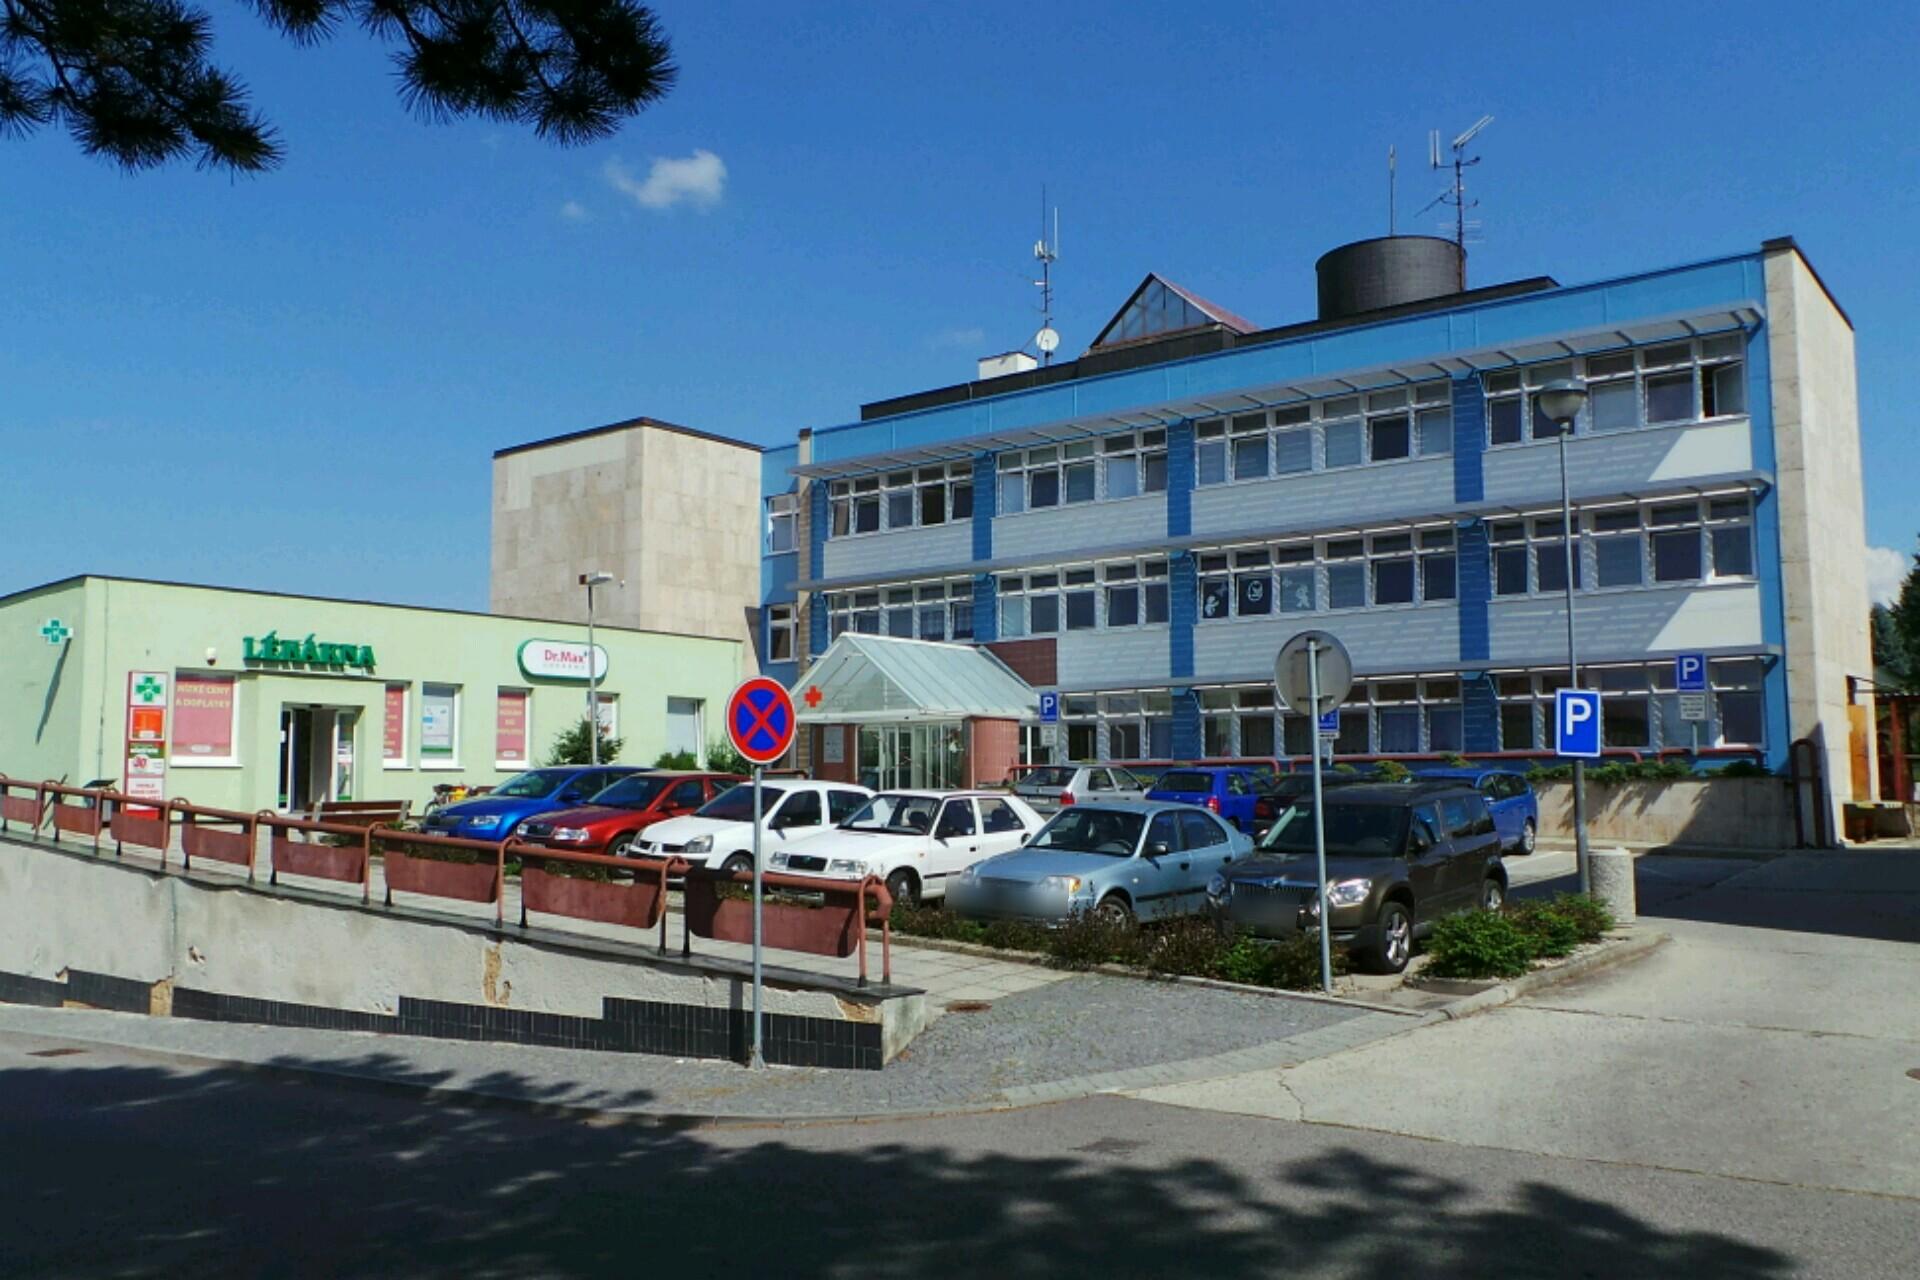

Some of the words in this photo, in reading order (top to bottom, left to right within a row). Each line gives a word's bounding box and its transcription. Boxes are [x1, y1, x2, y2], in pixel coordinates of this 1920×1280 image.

[242, 630, 377, 668] LÉKÁRNA
[544, 649, 584, 664] Dr.Max
[1682, 657, 1700, 680] P
[1043, 696, 1054, 713] P
[1566, 698, 1592, 735] P
